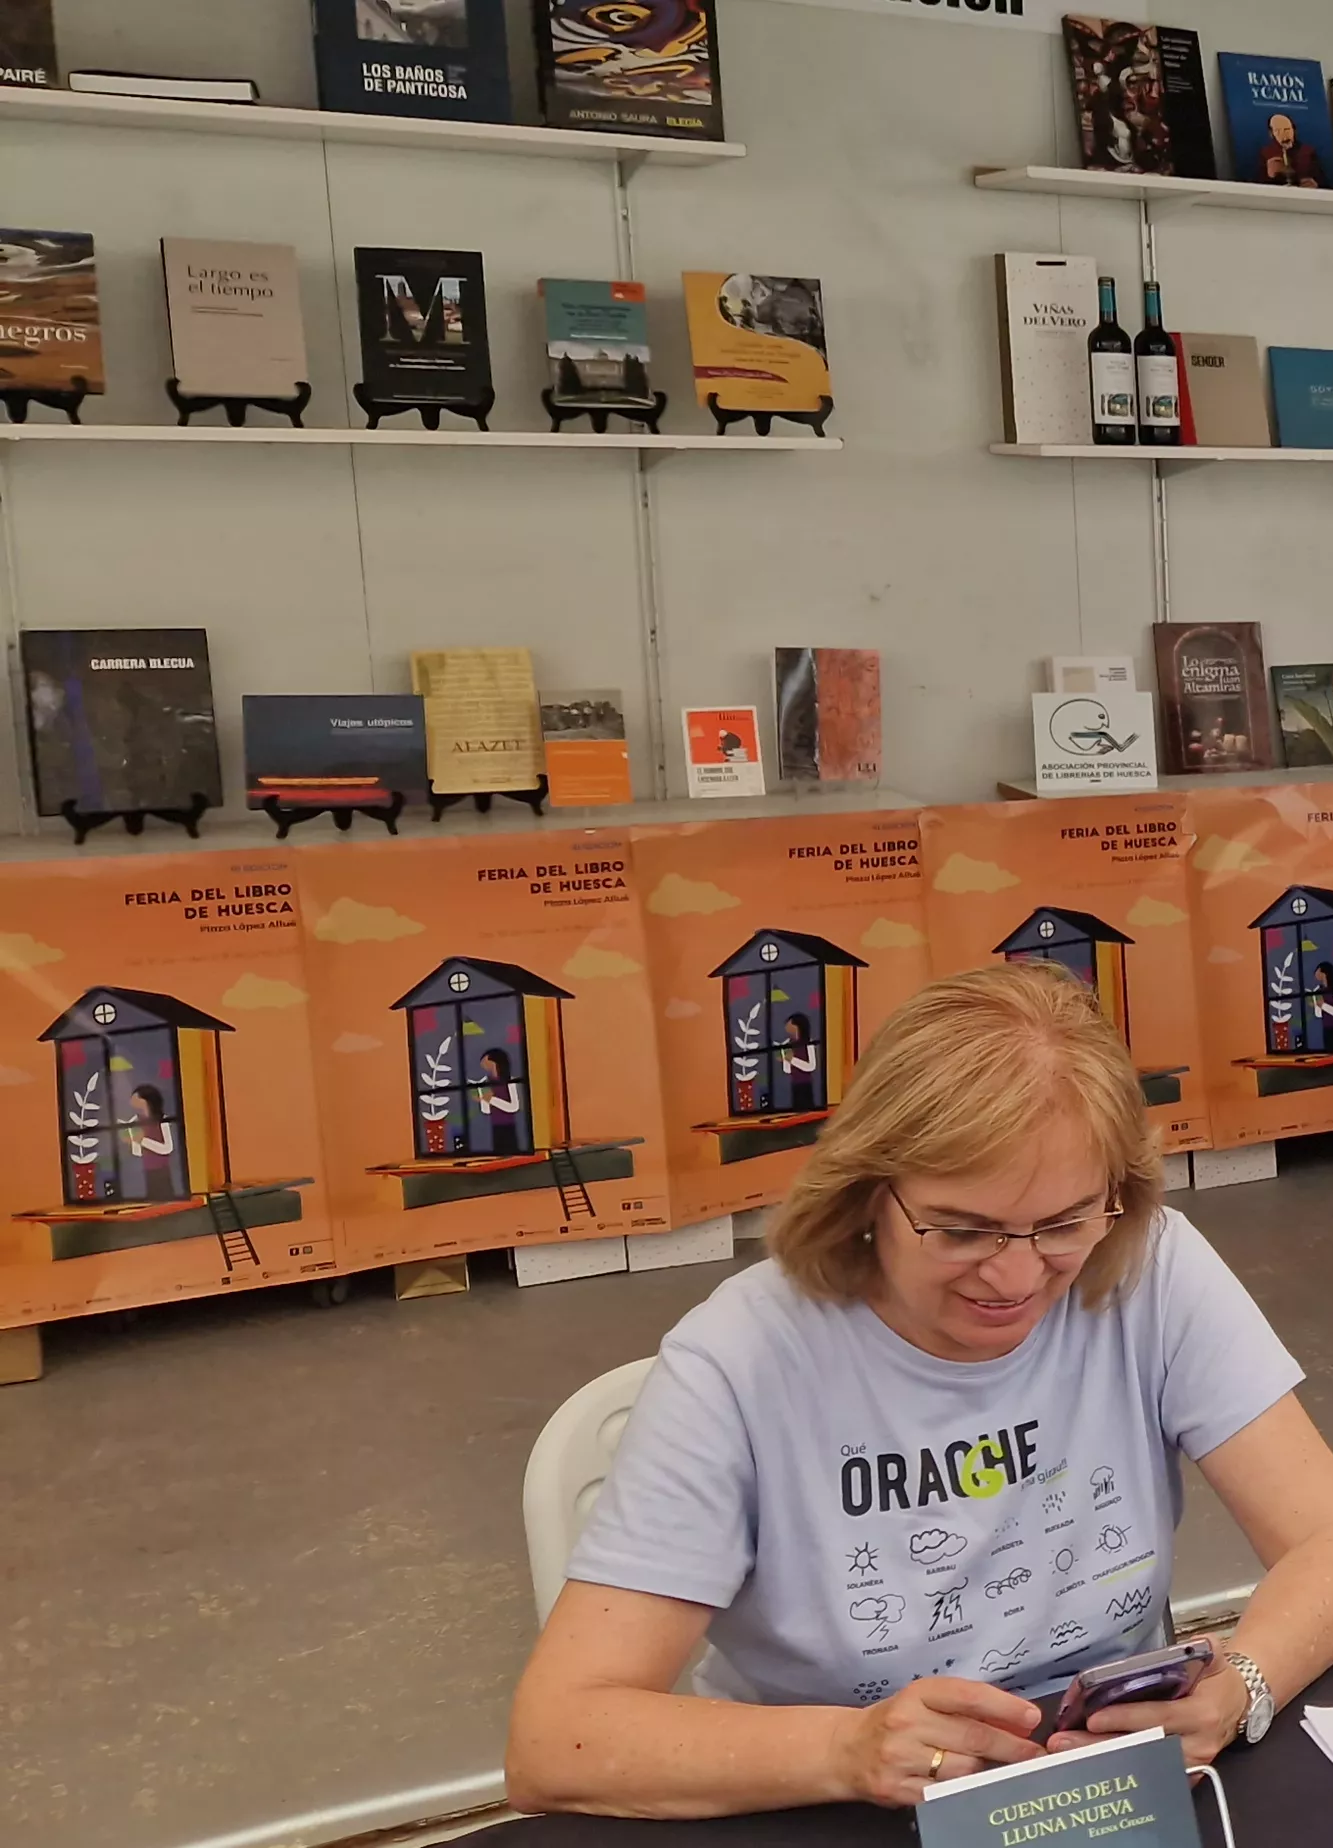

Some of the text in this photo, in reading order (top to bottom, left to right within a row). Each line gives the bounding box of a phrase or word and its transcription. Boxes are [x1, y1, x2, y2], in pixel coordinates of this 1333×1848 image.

[363, 63, 444, 82] LOS BAÑOS
[1248, 72, 1304, 88] RAMÓN
[364, 79, 467, 99] DE PANTICOSA
[1260, 88, 1308, 102] CAJAL
[569, 110, 617, 122] ANTONIO
[620, 112, 657, 124] SAURA
[187, 265, 269, 283] Largo es
[188, 281, 274, 301] el tiempo
[1032, 302, 1074, 314] VIÑAS
[1023, 316, 1087, 327] DEL VERO
[1191, 355, 1225, 368] SENDER
[91, 657, 195, 670] CARRERA BLECUA
[330, 717, 414, 728] Viajes utópicos
[1041, 761, 1148, 771] ASOCIACIÓN PROVINCIAL
[1116, 770, 1152, 778] HUESCA
[1061, 822, 1177, 839] FERIA DEL LIBRO
[788, 840, 918, 858] FERIA DEL LIBRO
[1101, 836, 1177, 851] DE HUESCA
[834, 855, 919, 870] DE HUESCA
[478, 861, 624, 881] FERIA DEL LIBRO
[530, 877, 626, 894] DE HUESCA
[125, 884, 292, 905] FERIA DEL LIBRO
[184, 901, 293, 919] DE HUESCA
[840, 1442, 867, 1457] Qué
[989, 1774, 1138, 1826] CUENTOS DE LA
[1002, 1798, 1135, 1848] LLUNA NUEVA
